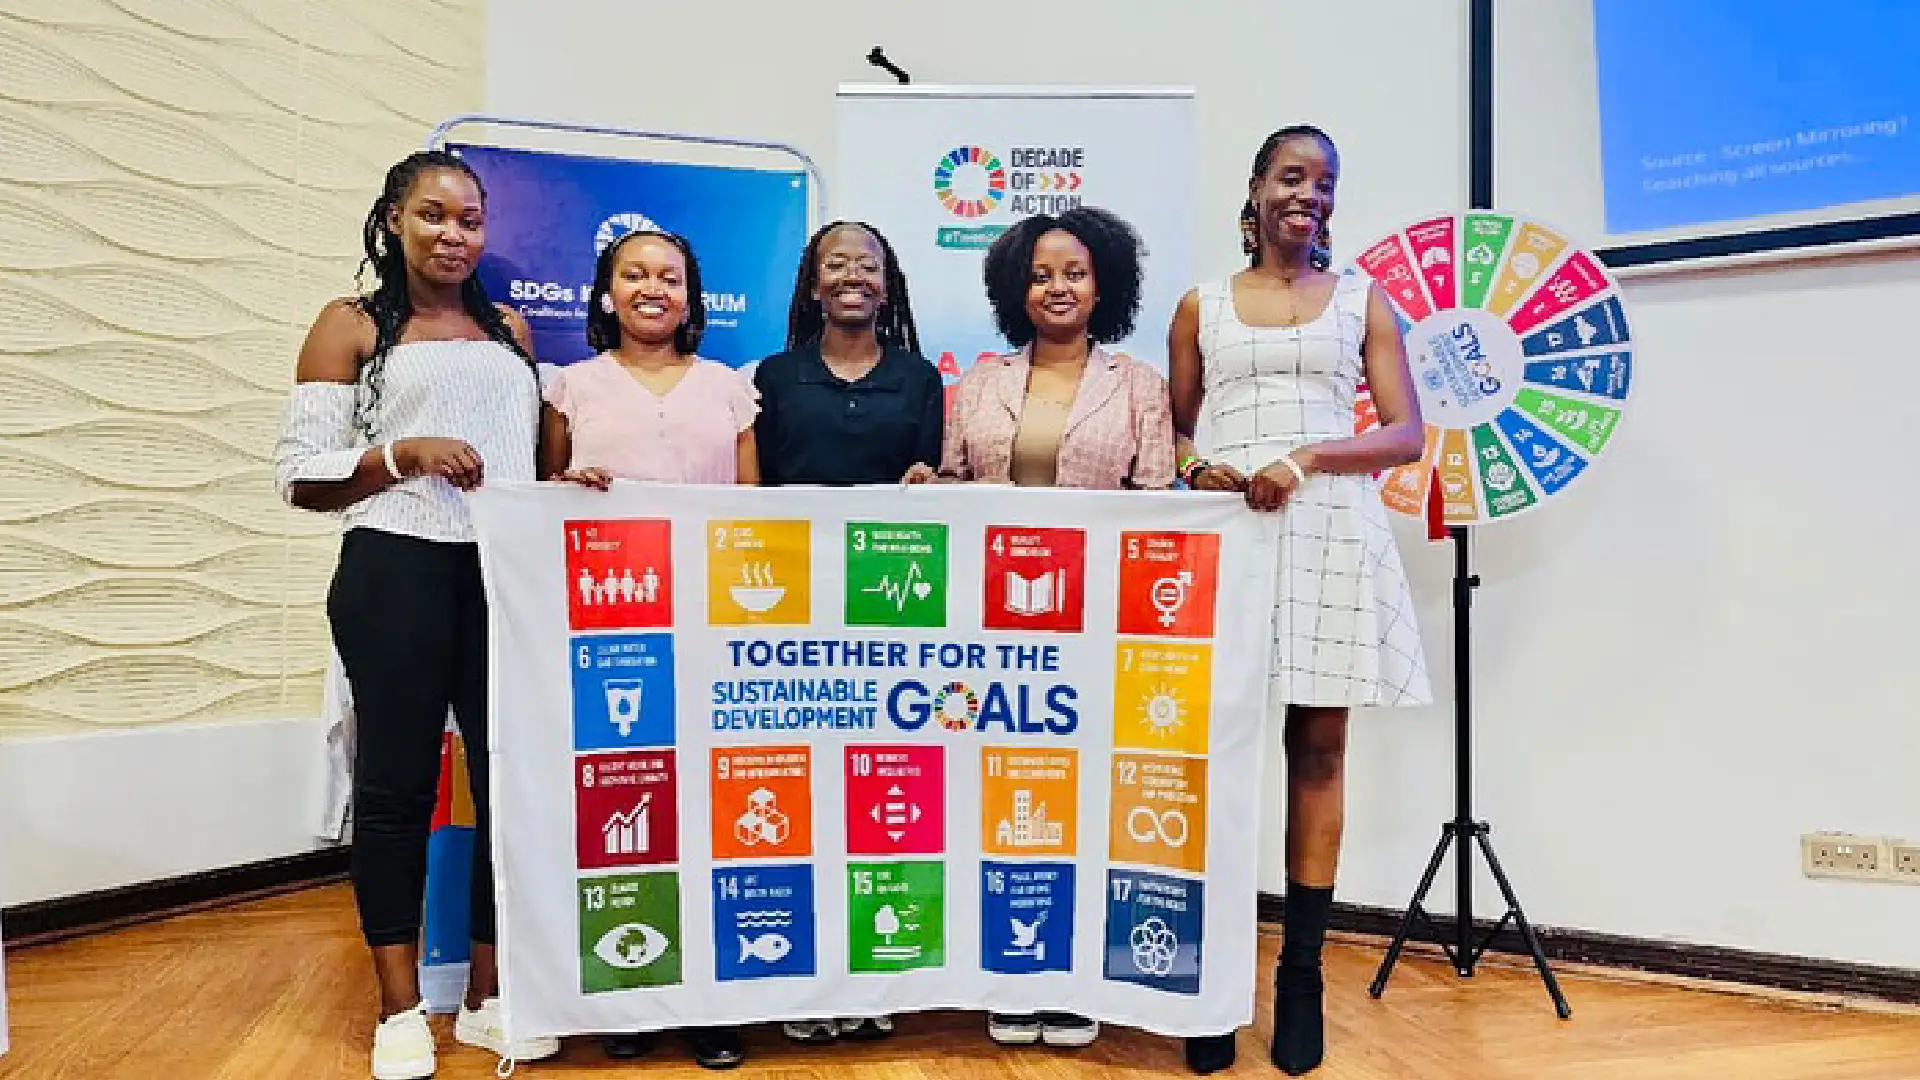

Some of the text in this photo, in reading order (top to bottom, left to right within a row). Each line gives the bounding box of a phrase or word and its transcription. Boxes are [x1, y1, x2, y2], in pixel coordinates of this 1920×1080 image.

[1011, 147, 1084, 168] DECADE
[1722, 138, 1790, 159] Screen
[1011, 173, 1035, 190] OF
[1643, 169, 1737, 191] Searching
[509, 280, 574, 302] SDGs
[701, 292, 746, 313] RUM
[568, 528, 581, 551] 1
[714, 527, 727, 548] 2
[853, 530, 867, 551] 3
[991, 533, 1005, 557] 4
[1127, 538, 1140, 559] 5
[579, 645, 592, 669] 6
[726, 640, 1060, 671] TOGETHER FOR THE
[1123, 648, 1134, 672] 7
[711, 678, 879, 704] SUSTAINABLE
[886, 680, 1079, 735] GOALS
[711, 707, 877, 732] DEVELOPMENT
[582, 764, 595, 788] 8
[717, 757, 730, 780] 9
[852, 753, 872, 776] 10
[986, 754, 1001, 777] 11
[1118, 761, 1137, 785] 12
[718, 875, 738, 900] 14
[853, 871, 873, 894] 15
[986, 871, 1005, 894] 16
[1112, 879, 1132, 901] 17
[584, 886, 605, 911] 13
